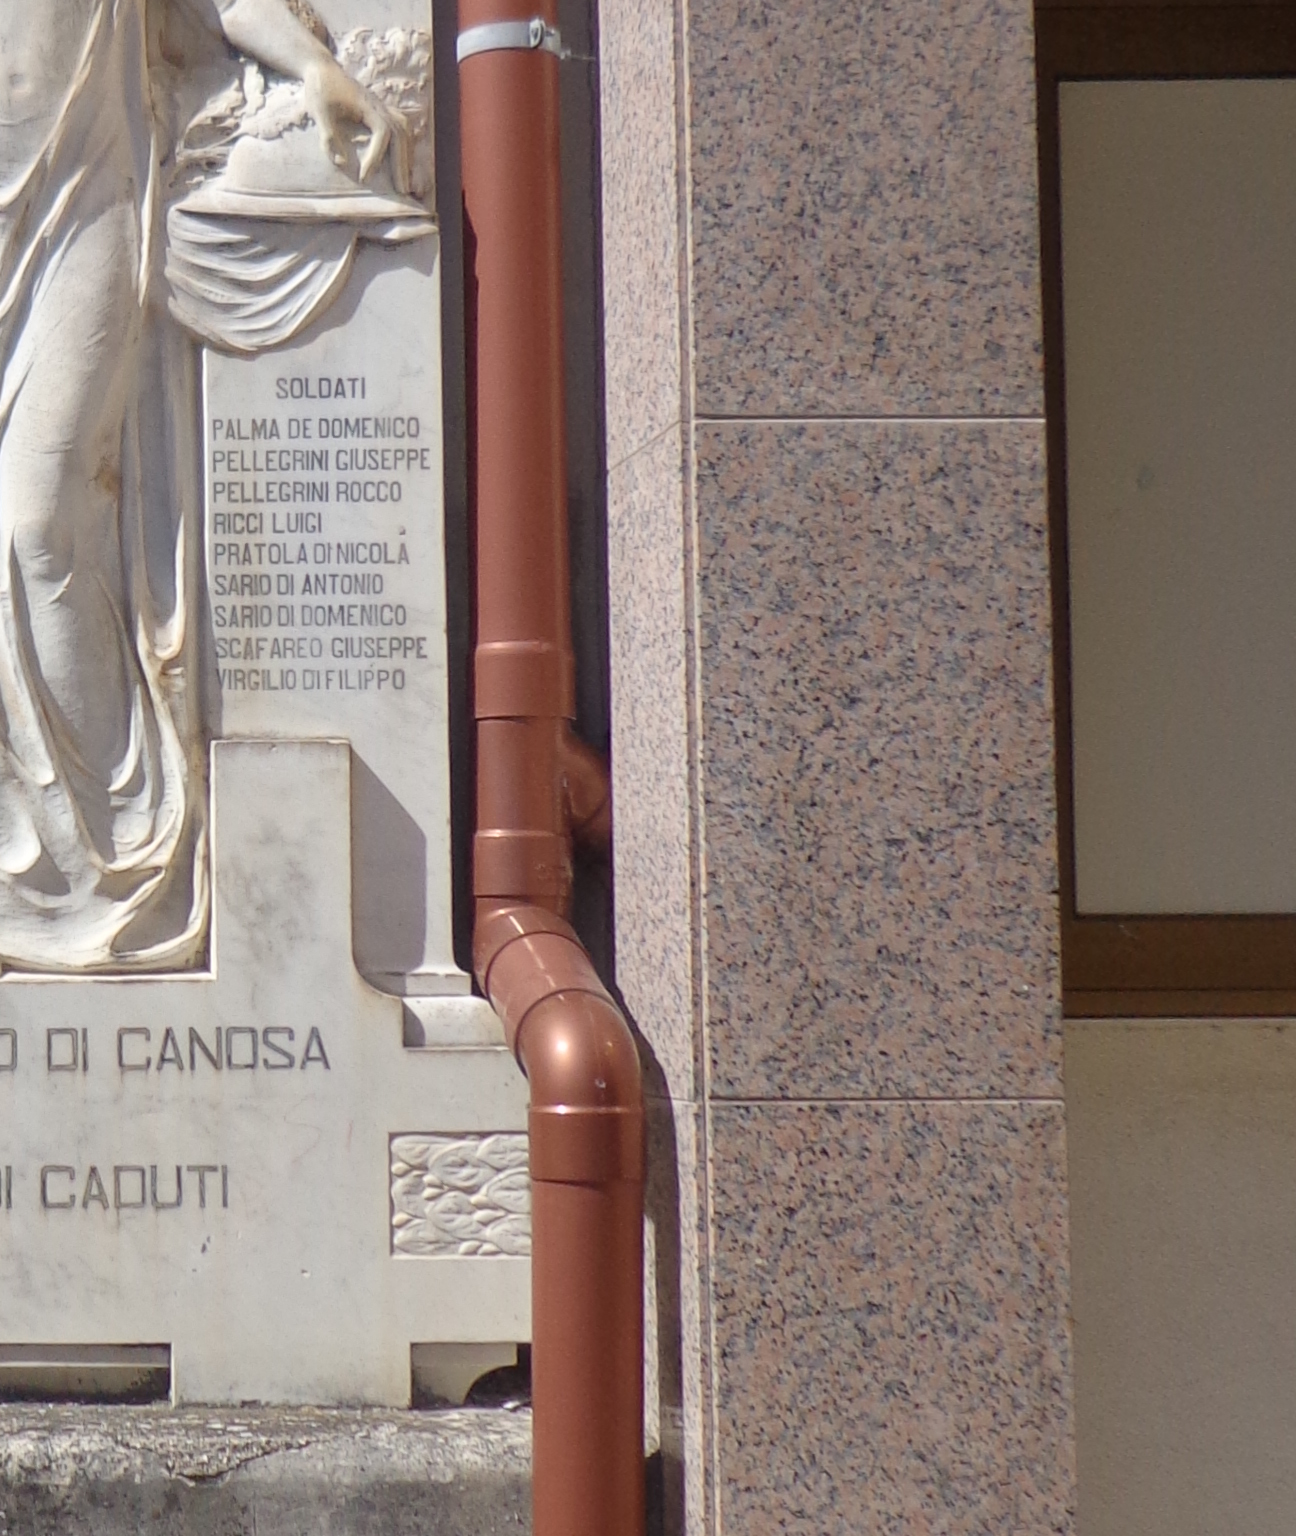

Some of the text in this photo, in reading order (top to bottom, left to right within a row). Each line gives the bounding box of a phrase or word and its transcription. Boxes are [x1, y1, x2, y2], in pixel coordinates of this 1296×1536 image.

[276, 378, 366, 400] SOLDATI
[212, 417, 419, 441] PALMA DE DOMENICO
[212, 448, 430, 472] PELLEGRINI GIUSEPPE
[213, 481, 402, 503] PELLEGRINI ROCCO
[213, 513, 321, 535] RICCI LUIGI
[214, 543, 410, 566] PRATOLA DI NICOLA
[214, 574, 383, 596] SARIO DI ANTONIO
[215, 605, 406, 628] SARIO DI DOMENICO
[331, 637, 428, 659] GIUSEPPE
[216, 669, 405, 691] VIRGILIO DI FILIPPO
[47, 1027, 90, 1071] DI
[117, 1026, 331, 1071] CANOSA
[39, 1164, 230, 1209] CADUTI
